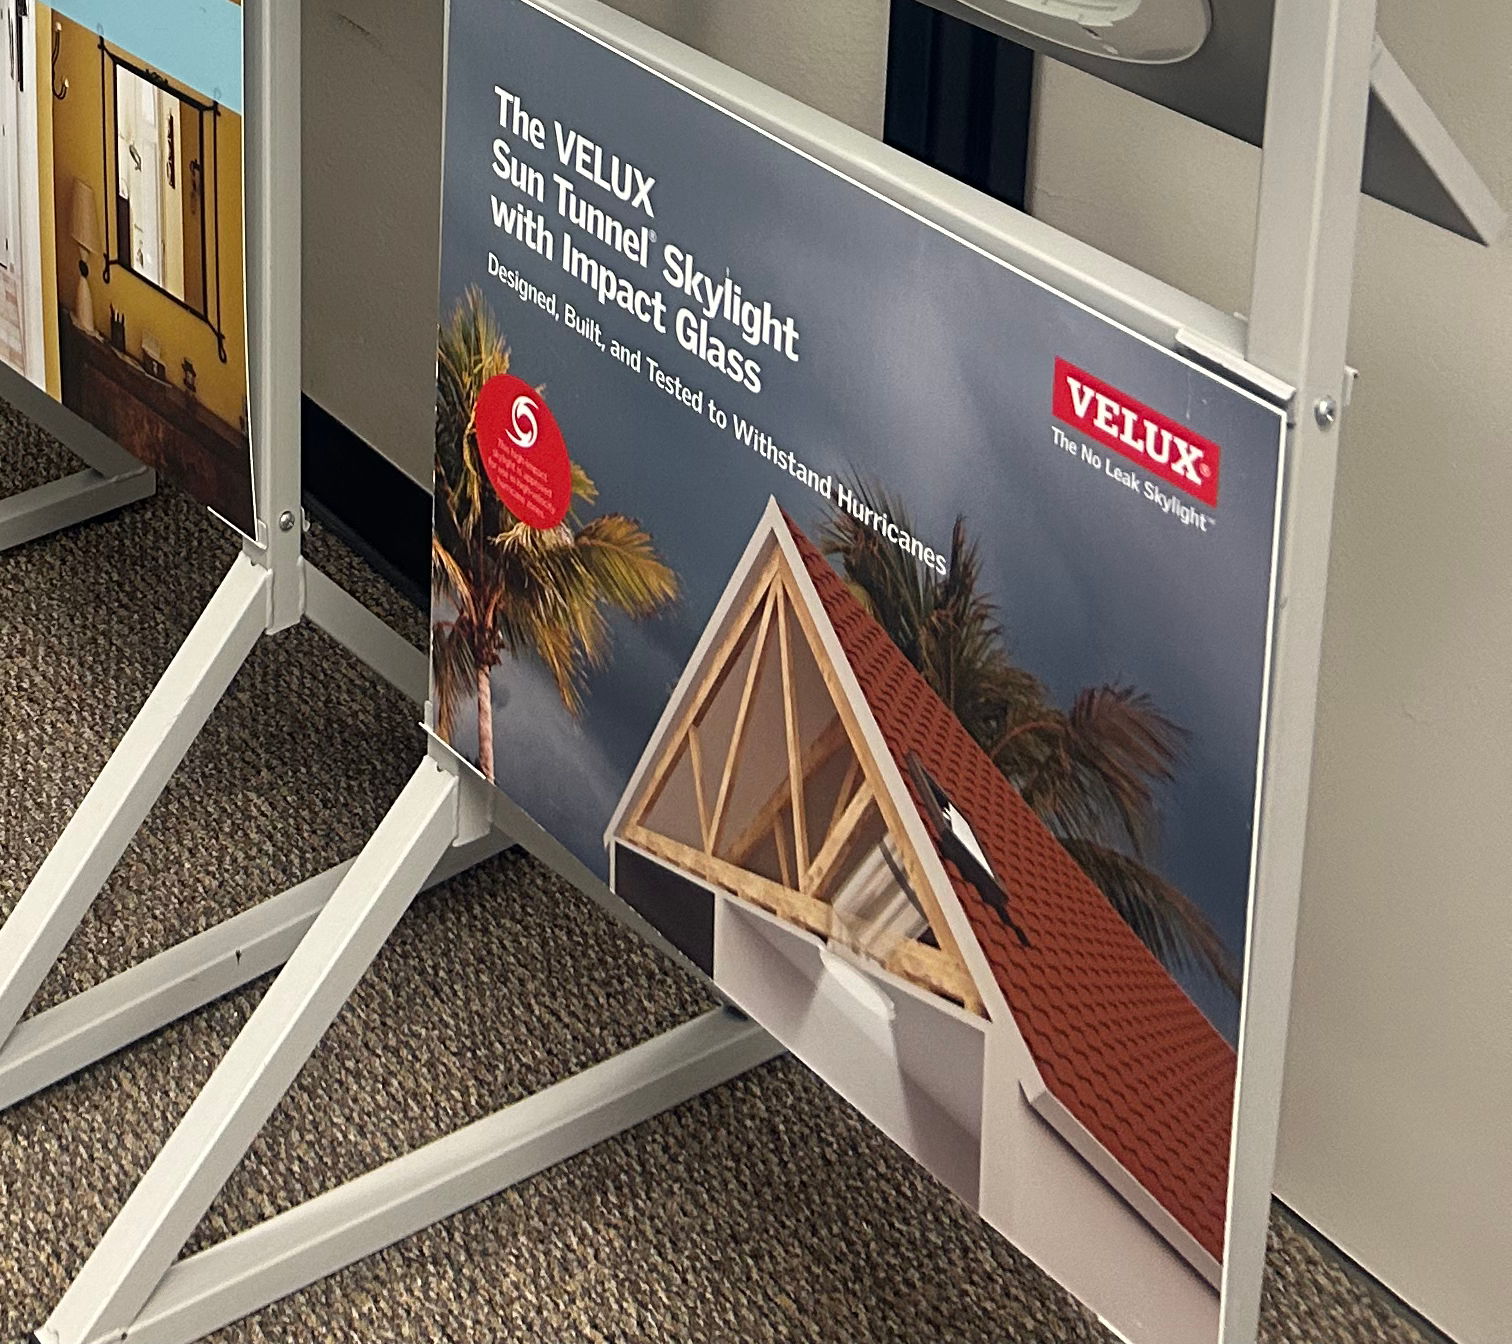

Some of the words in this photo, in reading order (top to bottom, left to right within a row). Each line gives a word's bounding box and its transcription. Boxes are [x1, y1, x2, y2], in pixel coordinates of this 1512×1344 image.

[494, 85, 546, 150] The
[554, 120, 656, 219] VELUX
[491, 138, 545, 203] Sun
[662, 244, 800, 362] Skylight
[491, 194, 554, 262] with
[562, 232, 667, 334] Impact
[675, 307, 762, 394] Glass
[488, 251, 560, 321] Designed,
[564, 303, 606, 352] Built,
[610, 338, 642, 375] and
[646, 356, 704, 415] Tested
[707, 398, 728, 430] to
[733, 413, 833, 500] Withstand
[837, 483, 948, 576] Hurricanes
[1051, 425, 1077, 455] The
[1082, 443, 1102, 470] No
[1105, 458, 1140, 493] Leak
[1143, 481, 1207, 532] Skylight
[1067, 375, 1204, 485] VELUX
